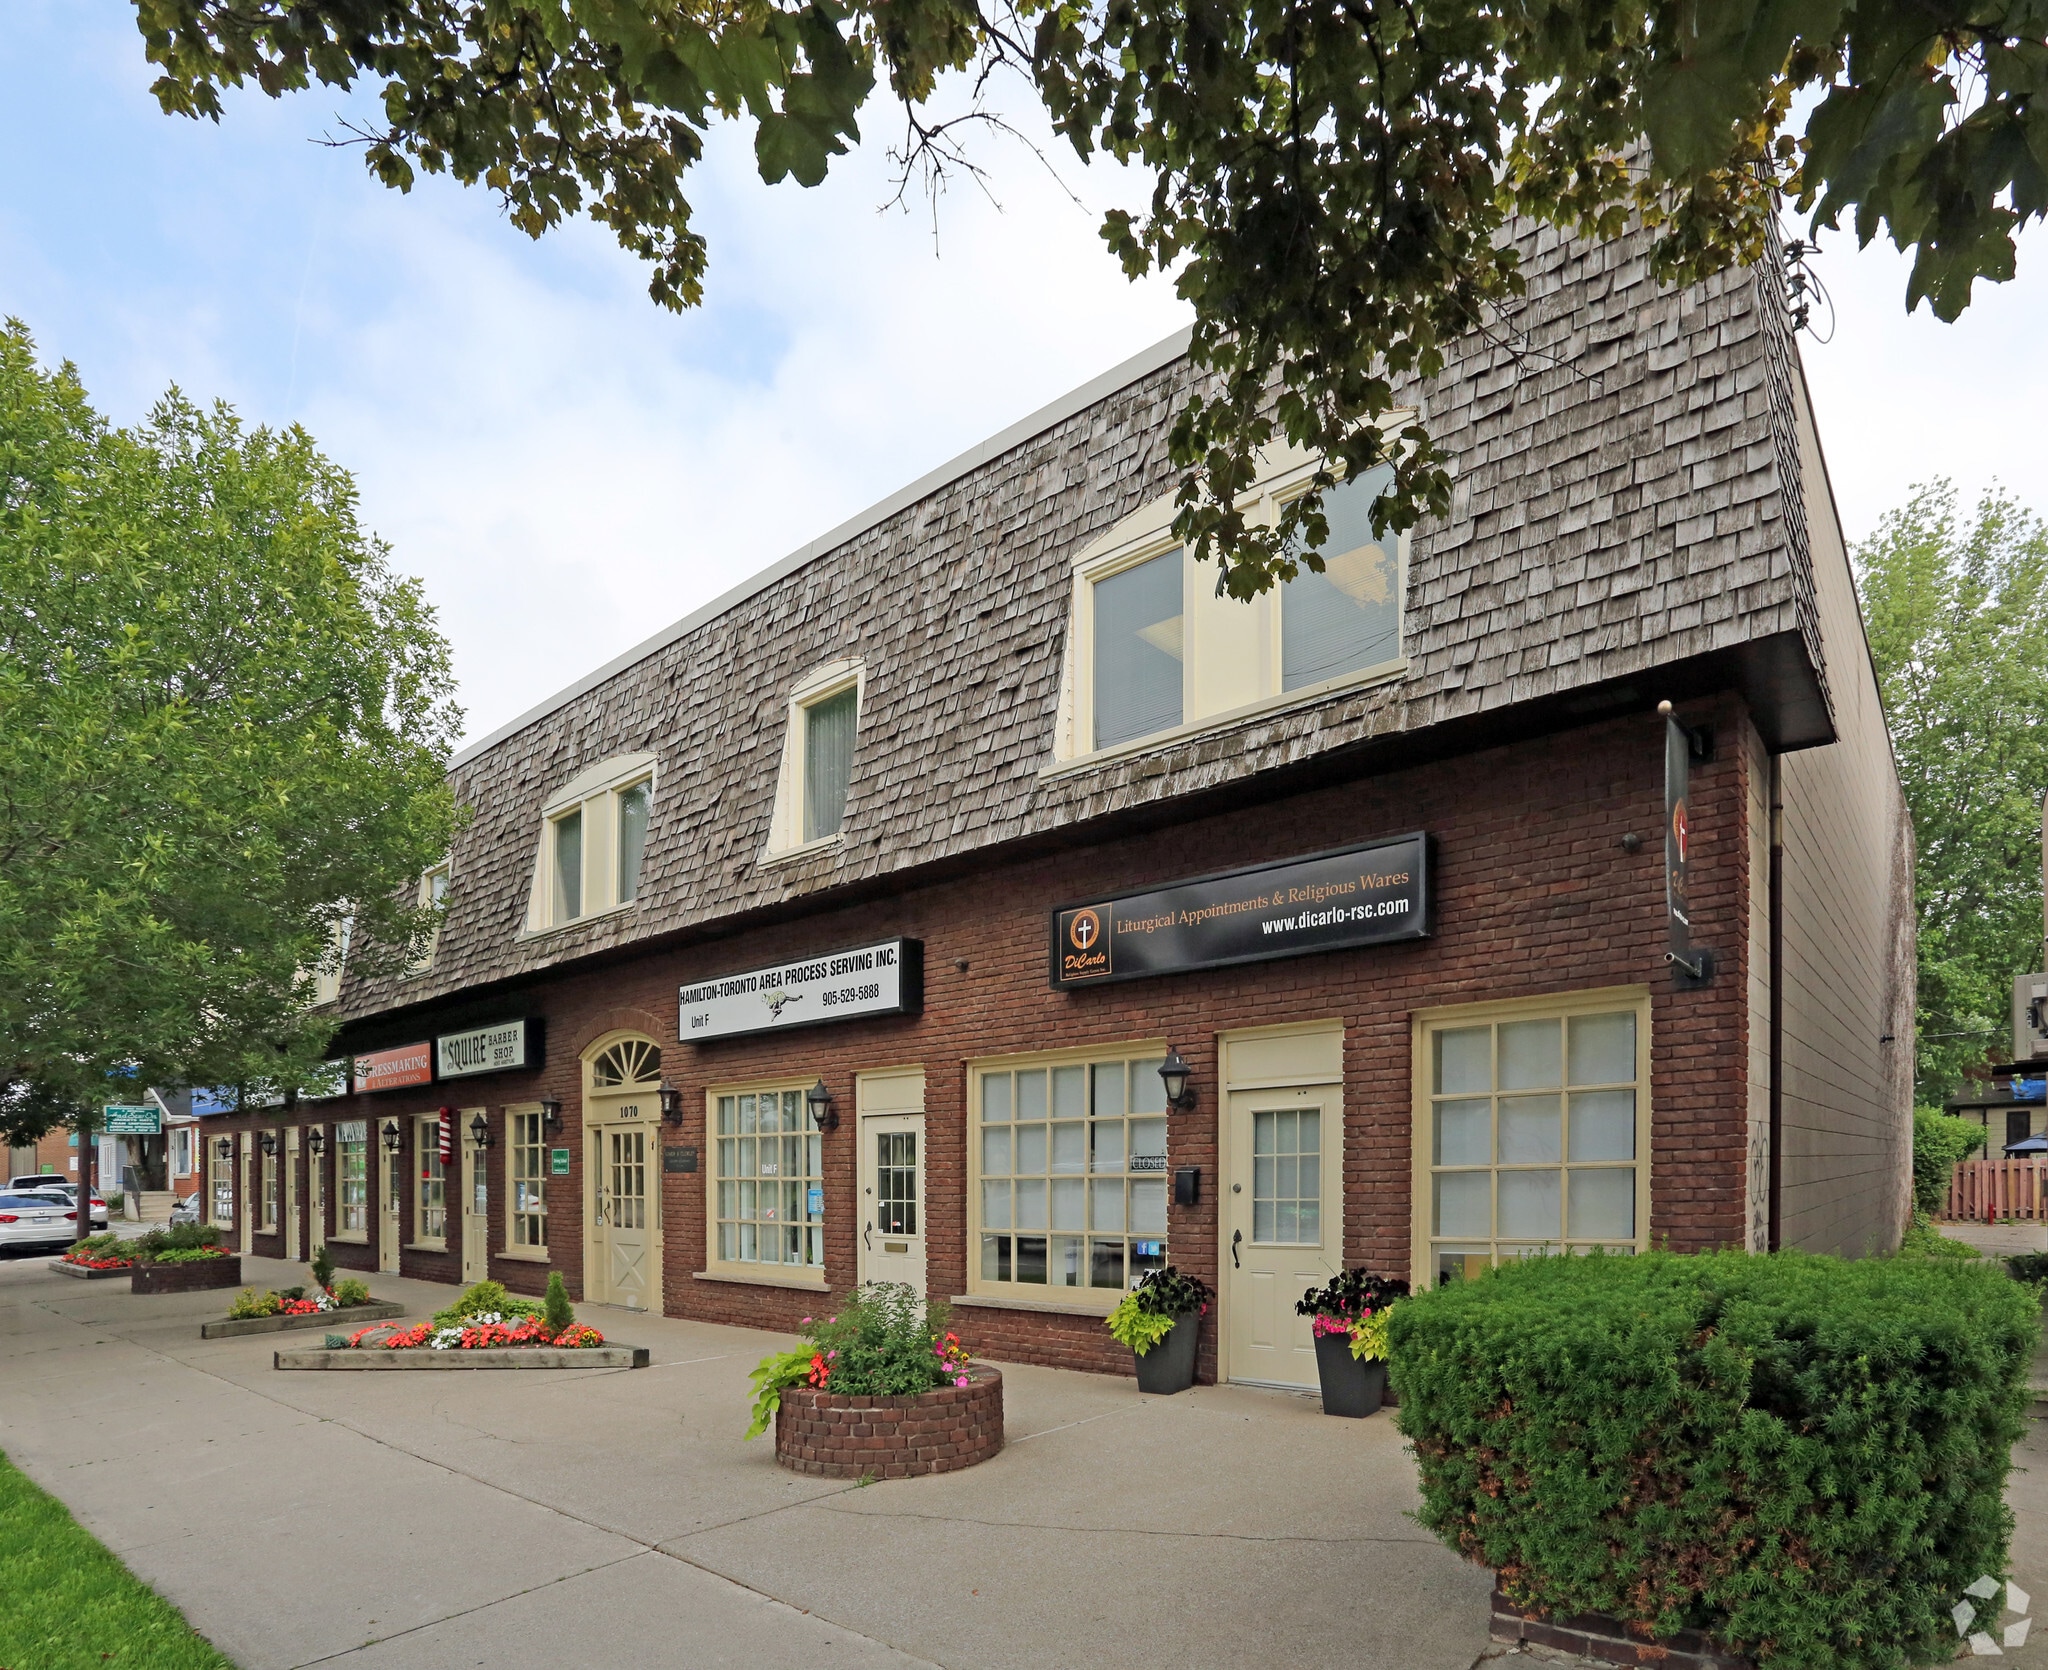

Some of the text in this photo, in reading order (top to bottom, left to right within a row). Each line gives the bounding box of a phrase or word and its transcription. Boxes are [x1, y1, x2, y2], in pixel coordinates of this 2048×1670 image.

[1117, 911, 1175, 934] Liturgical
[1178, 896, 1269, 926] Appointments
[1272, 891, 1285, 906] &
[1288, 881, 1356, 903] Religious
[1360, 872, 1409, 890] Wares
[1262, 898, 1409, 935] www.dicarlo-rsc.com
[1065, 952, 1106, 969] DiCarlo
[680, 948, 897, 1005] HAMILTON-TORONTO AREA PROCESS SERVING INC.
[822, 983, 879, 1006] 905-529-5888
[691, 1013, 709, 1028] Unit F
[489, 1030, 518, 1046] BARBER
[447, 1034, 486, 1070] SQUIRE
[494, 1046, 514, 1059] SHOP
[377, 1073, 421, 1087] ALTERATIONS
[620, 1105, 638, 1118] 1070
[762, 1164, 777, 1174] Unit F
[1132, 1157, 1166, 1169] CLOSED
